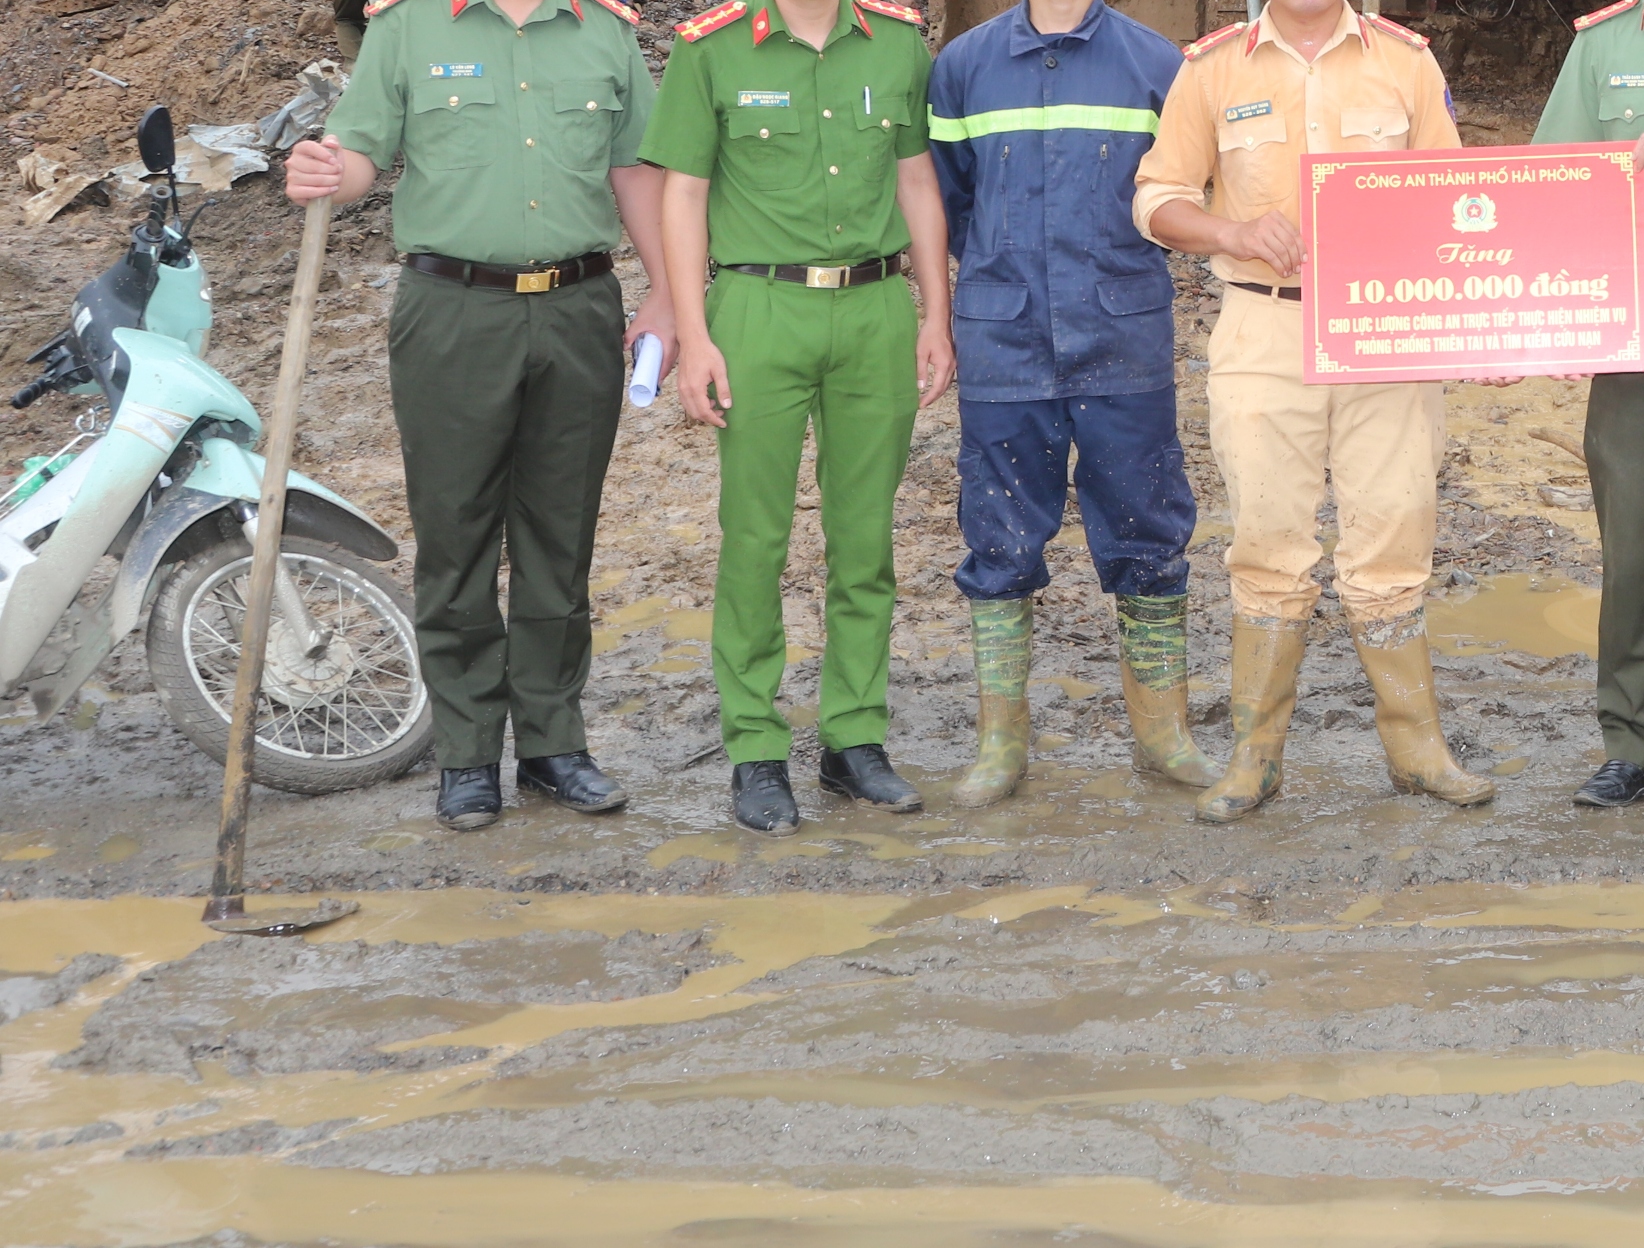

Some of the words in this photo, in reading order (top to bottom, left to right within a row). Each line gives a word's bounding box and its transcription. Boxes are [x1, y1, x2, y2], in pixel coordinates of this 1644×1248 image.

[1355, 172, 1402, 189] CÔNG
[1404, 174, 1426, 188] AN
[1428, 169, 1475, 186] THÀNH
[1478, 166, 1508, 184] PHỐ
[1512, 164, 1536, 183] HẢI
[1539, 164, 1592, 182] PHÒNG
[1436, 243, 1515, 268] Tặng
[1346, 274, 1524, 304] 10.000.000
[1530, 268, 1609, 301] đồng
[1328, 318, 1350, 334] CHO
[1352, 316, 1373, 336] LỰC
[1375, 315, 1410, 335] LƯỢNG
[1413, 312, 1442, 331] CÔNG
[1445, 314, 1460, 329] AN
[1462, 312, 1490, 331] TRỰC
[1492, 307, 1515, 327] TIẾP
[1518, 310, 1545, 329] THỰC
[1548, 307, 1572, 328] HIỆN
[1575, 306, 1610, 326] NHIỆM
[1612, 307, 1626, 325] VỤ
[1355, 336, 1392, 355] PHÒNG
[1394, 333, 1431, 354] CHỐNG
[1433, 334, 1464, 352] THIÊN
[1466, 335, 1483, 351] TAI
[1486, 332, 1500, 350] VÀ
[1502, 331, 1521, 349] TÌM
[1524, 328, 1551, 348] KIẾM
[1554, 328, 1575, 347] CỨU
[1578, 331, 1601, 349] NẠN
